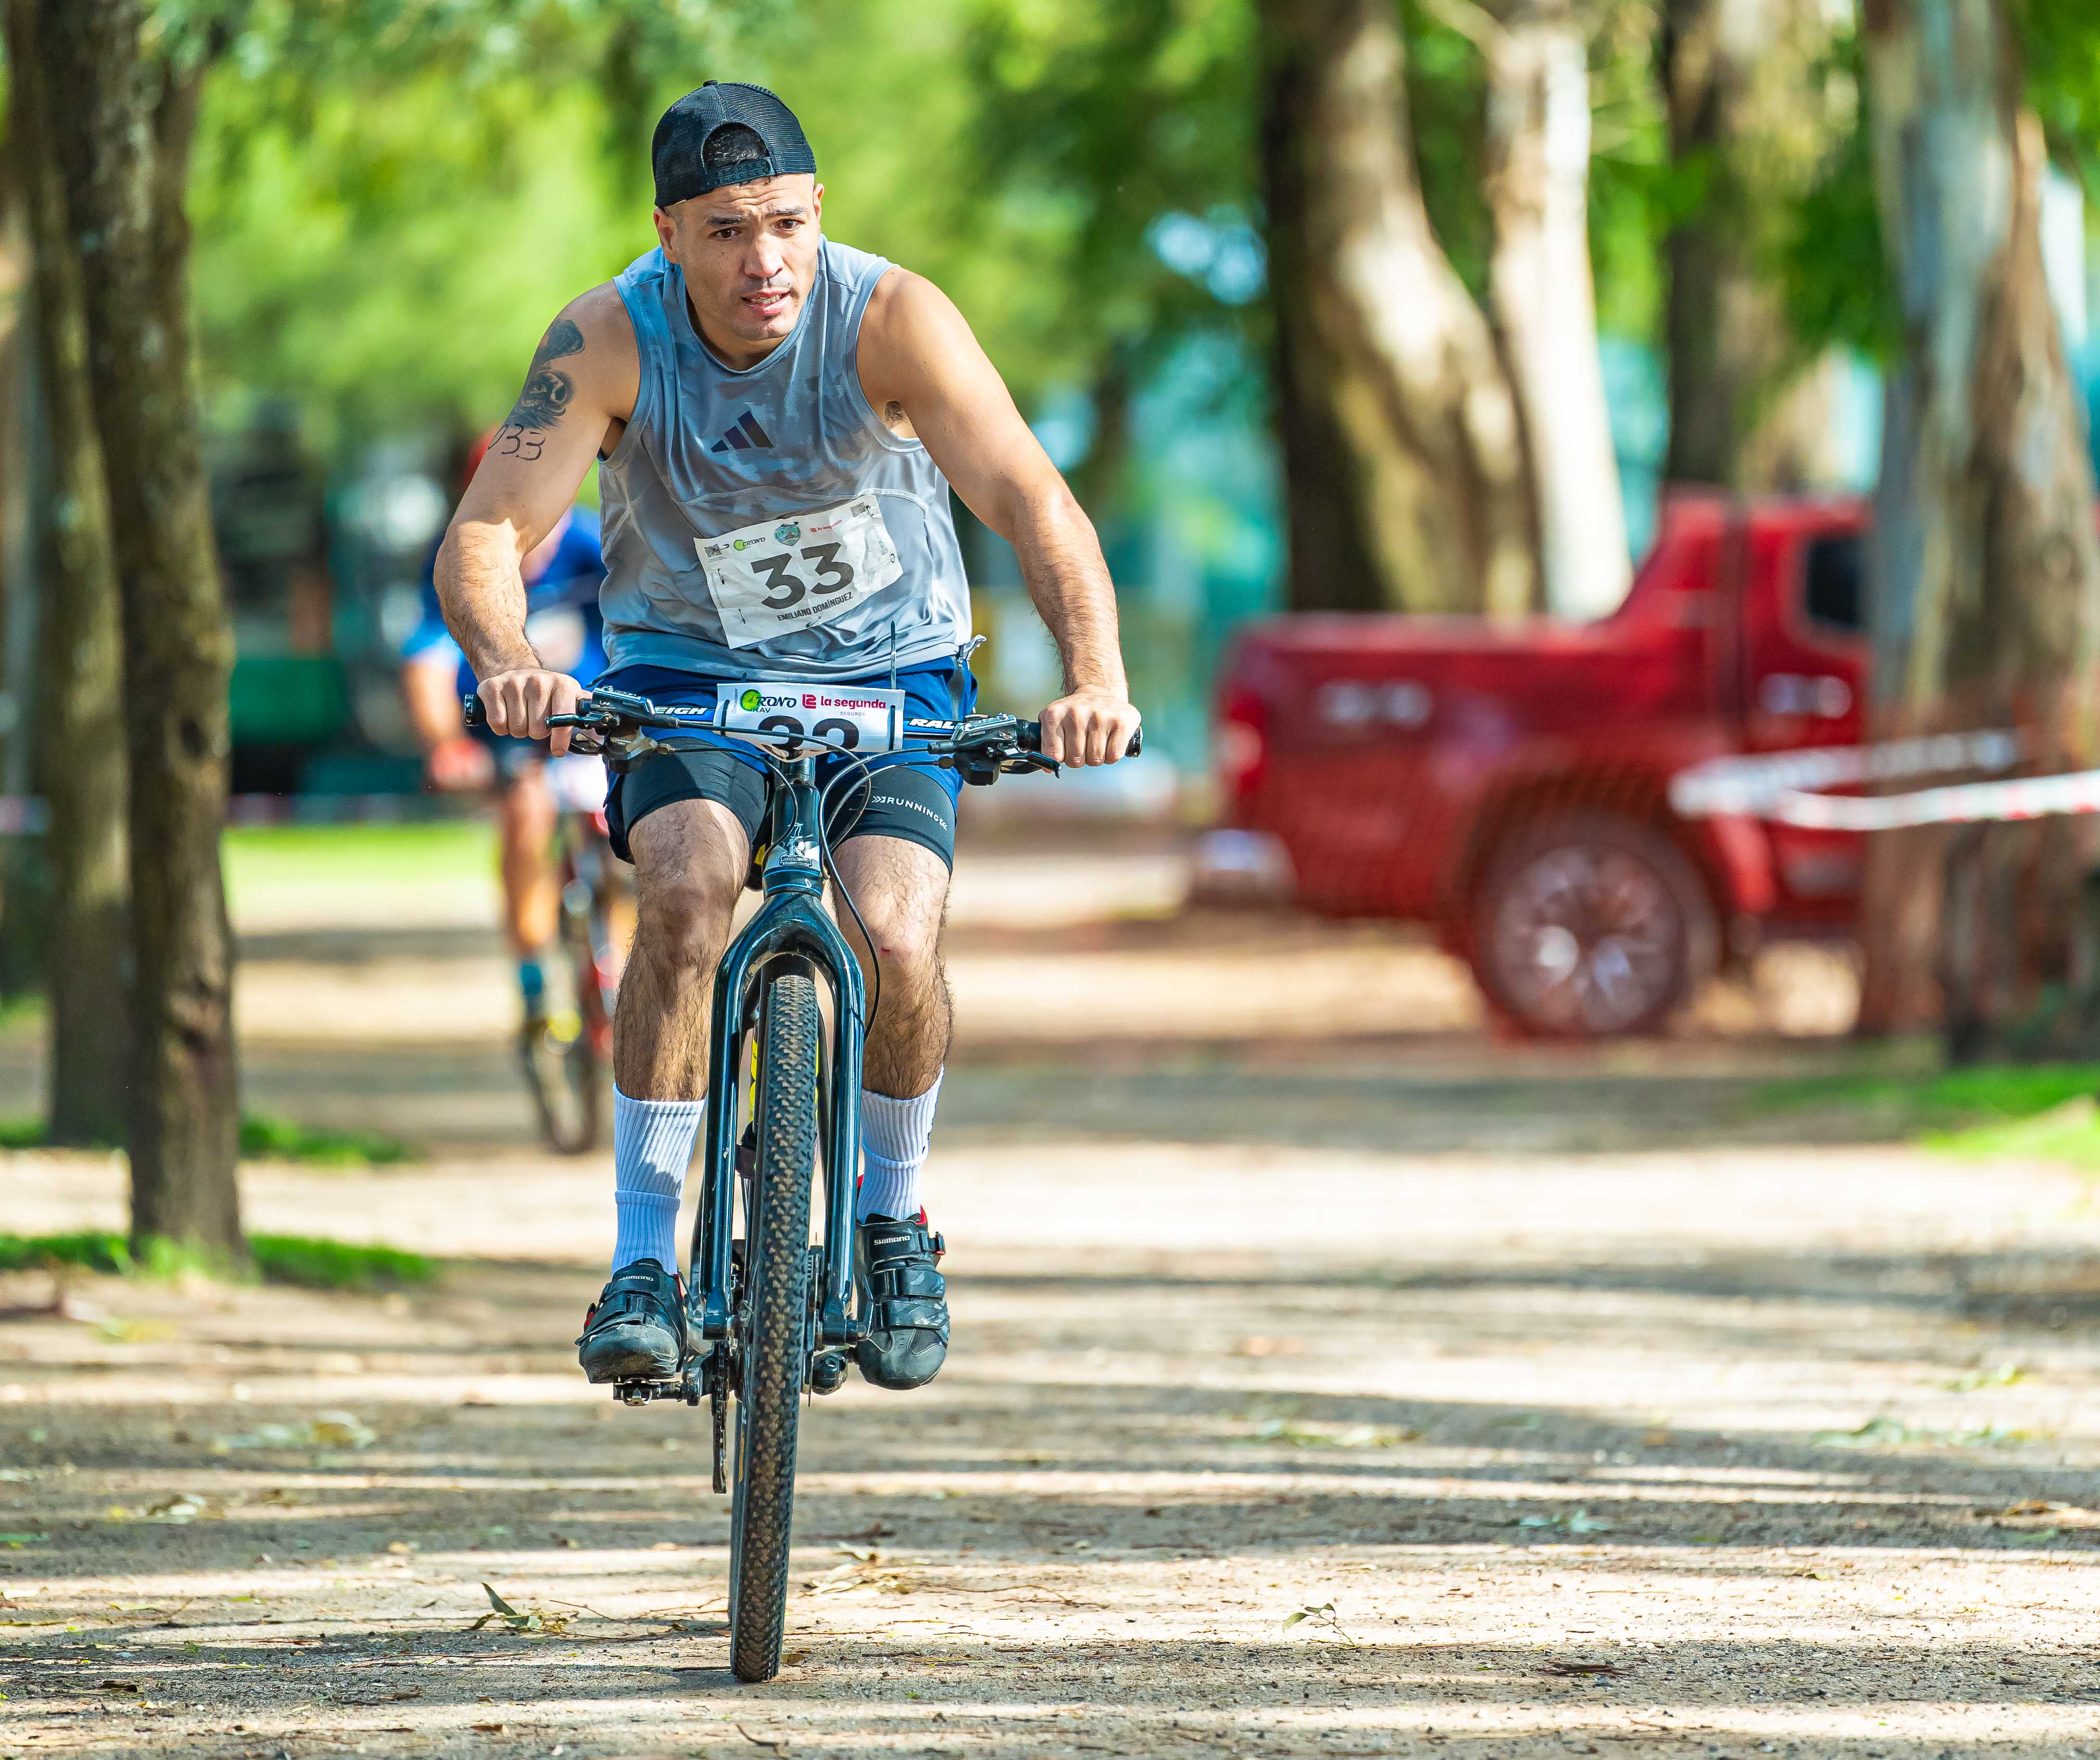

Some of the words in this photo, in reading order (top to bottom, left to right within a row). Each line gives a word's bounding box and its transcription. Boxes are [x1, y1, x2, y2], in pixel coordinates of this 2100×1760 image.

[751, 542, 854, 610] 33
[777, 608, 812, 621] EMILIANO
[811, 591, 853, 614] DOMÍNGUEZ
[820, 696, 832, 706] la
[834, 698, 886, 710] segunda
[874, 1235, 910, 1246] SHIMANO
